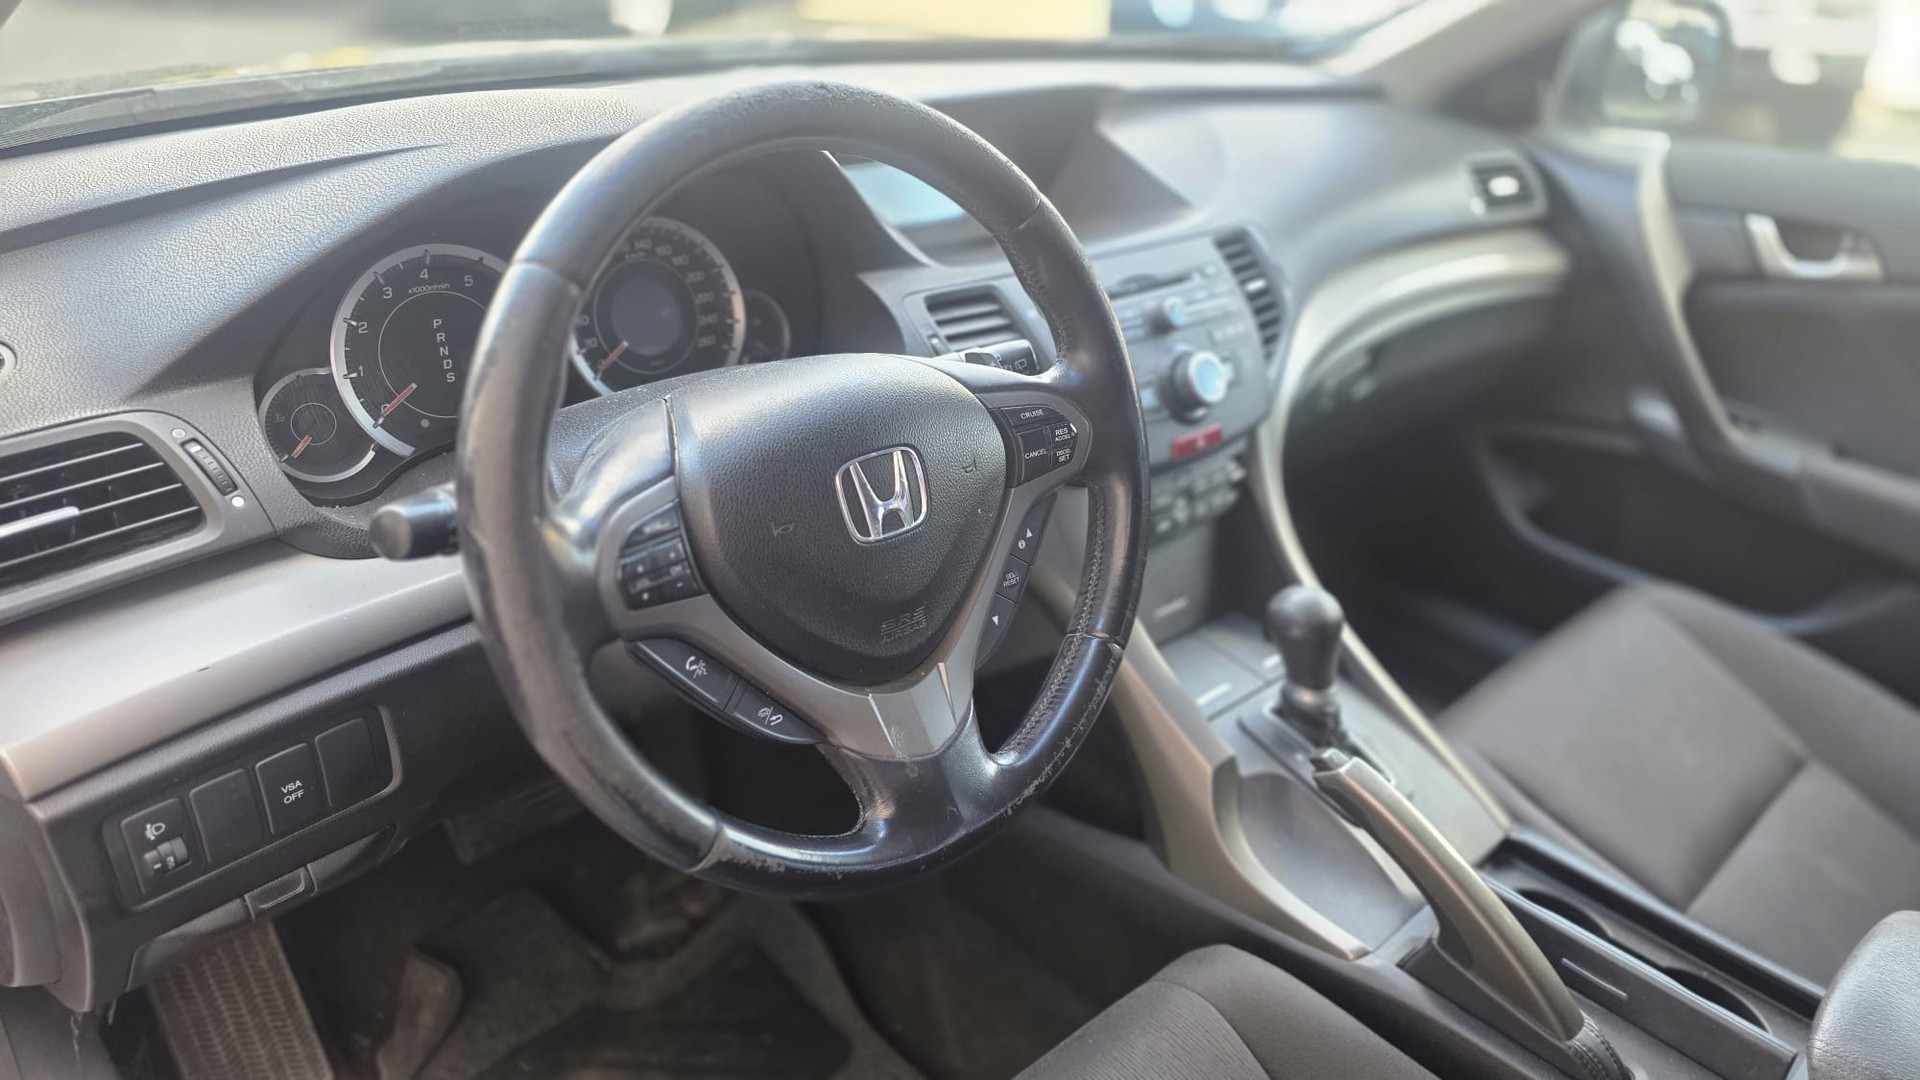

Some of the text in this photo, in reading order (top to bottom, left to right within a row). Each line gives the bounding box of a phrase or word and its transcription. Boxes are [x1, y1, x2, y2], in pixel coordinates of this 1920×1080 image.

[420, 269, 429, 280] 4
[464, 275, 474, 287] 5
[383, 287, 393, 299] 3
[358, 322, 368, 334] 2
[433, 318, 442, 329] P
[436, 332, 446, 343] R
[440, 345, 449, 356] N
[443, 359, 453, 369] D
[358, 365, 364, 377] 1
[446, 372, 456, 383] S
[1020, 409, 1045, 419] CRUISE
[1055, 427, 1069, 436] RES
[1024, 448, 1047, 459] CANCEL
[1058, 454, 1071, 463] SET
[1005, 571, 1017, 580] SEL
[1002, 576, 1020, 588] RESET
[280, 779, 303, 794] VSA
[283, 789, 305, 804] OFF
